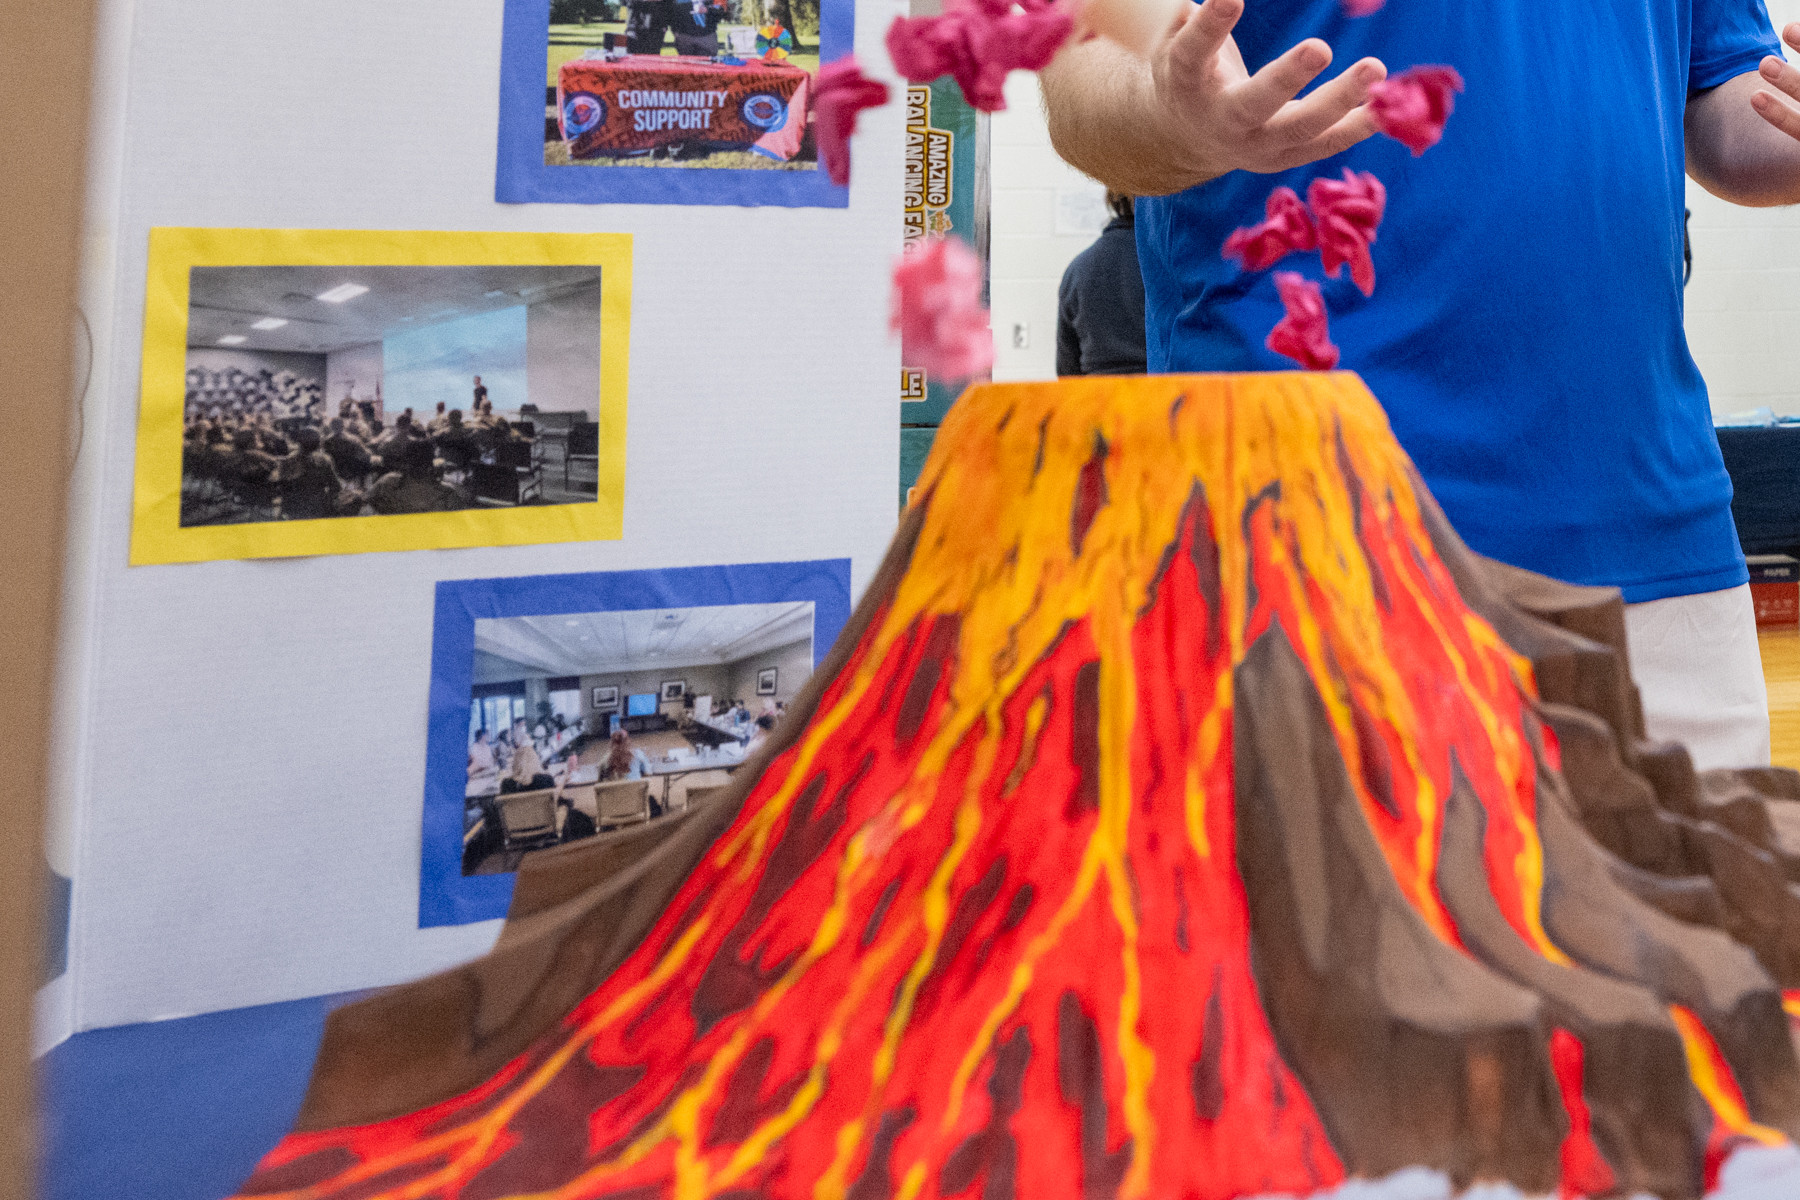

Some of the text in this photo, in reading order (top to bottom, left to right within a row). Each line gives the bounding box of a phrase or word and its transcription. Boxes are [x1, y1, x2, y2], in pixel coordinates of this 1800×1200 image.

[618, 90, 729, 109] COMMUNITY
[634, 109, 714, 131] SUPPORT
[928, 133, 947, 204] AMAZING
